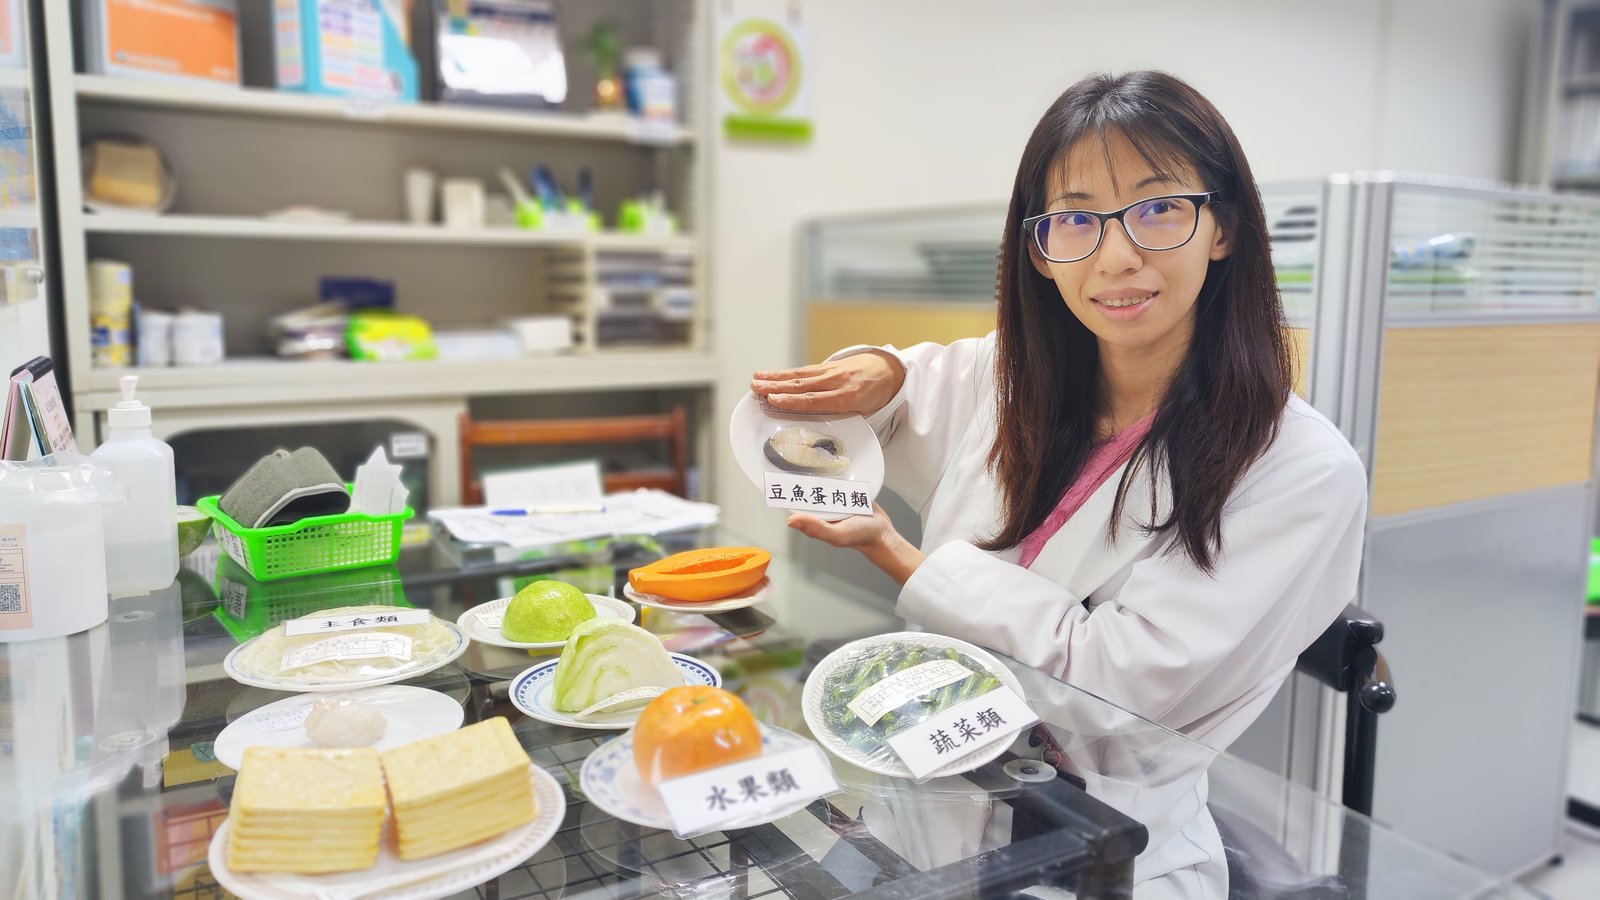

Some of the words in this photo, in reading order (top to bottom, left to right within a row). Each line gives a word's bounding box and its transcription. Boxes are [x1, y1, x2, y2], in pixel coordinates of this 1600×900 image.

[768, 483, 870, 509] 豆魚蛋肉類
[320, 615, 399, 629] 主食類
[929, 707, 1007, 755] 蔬菜類
[705, 768, 801, 812] 水果類
